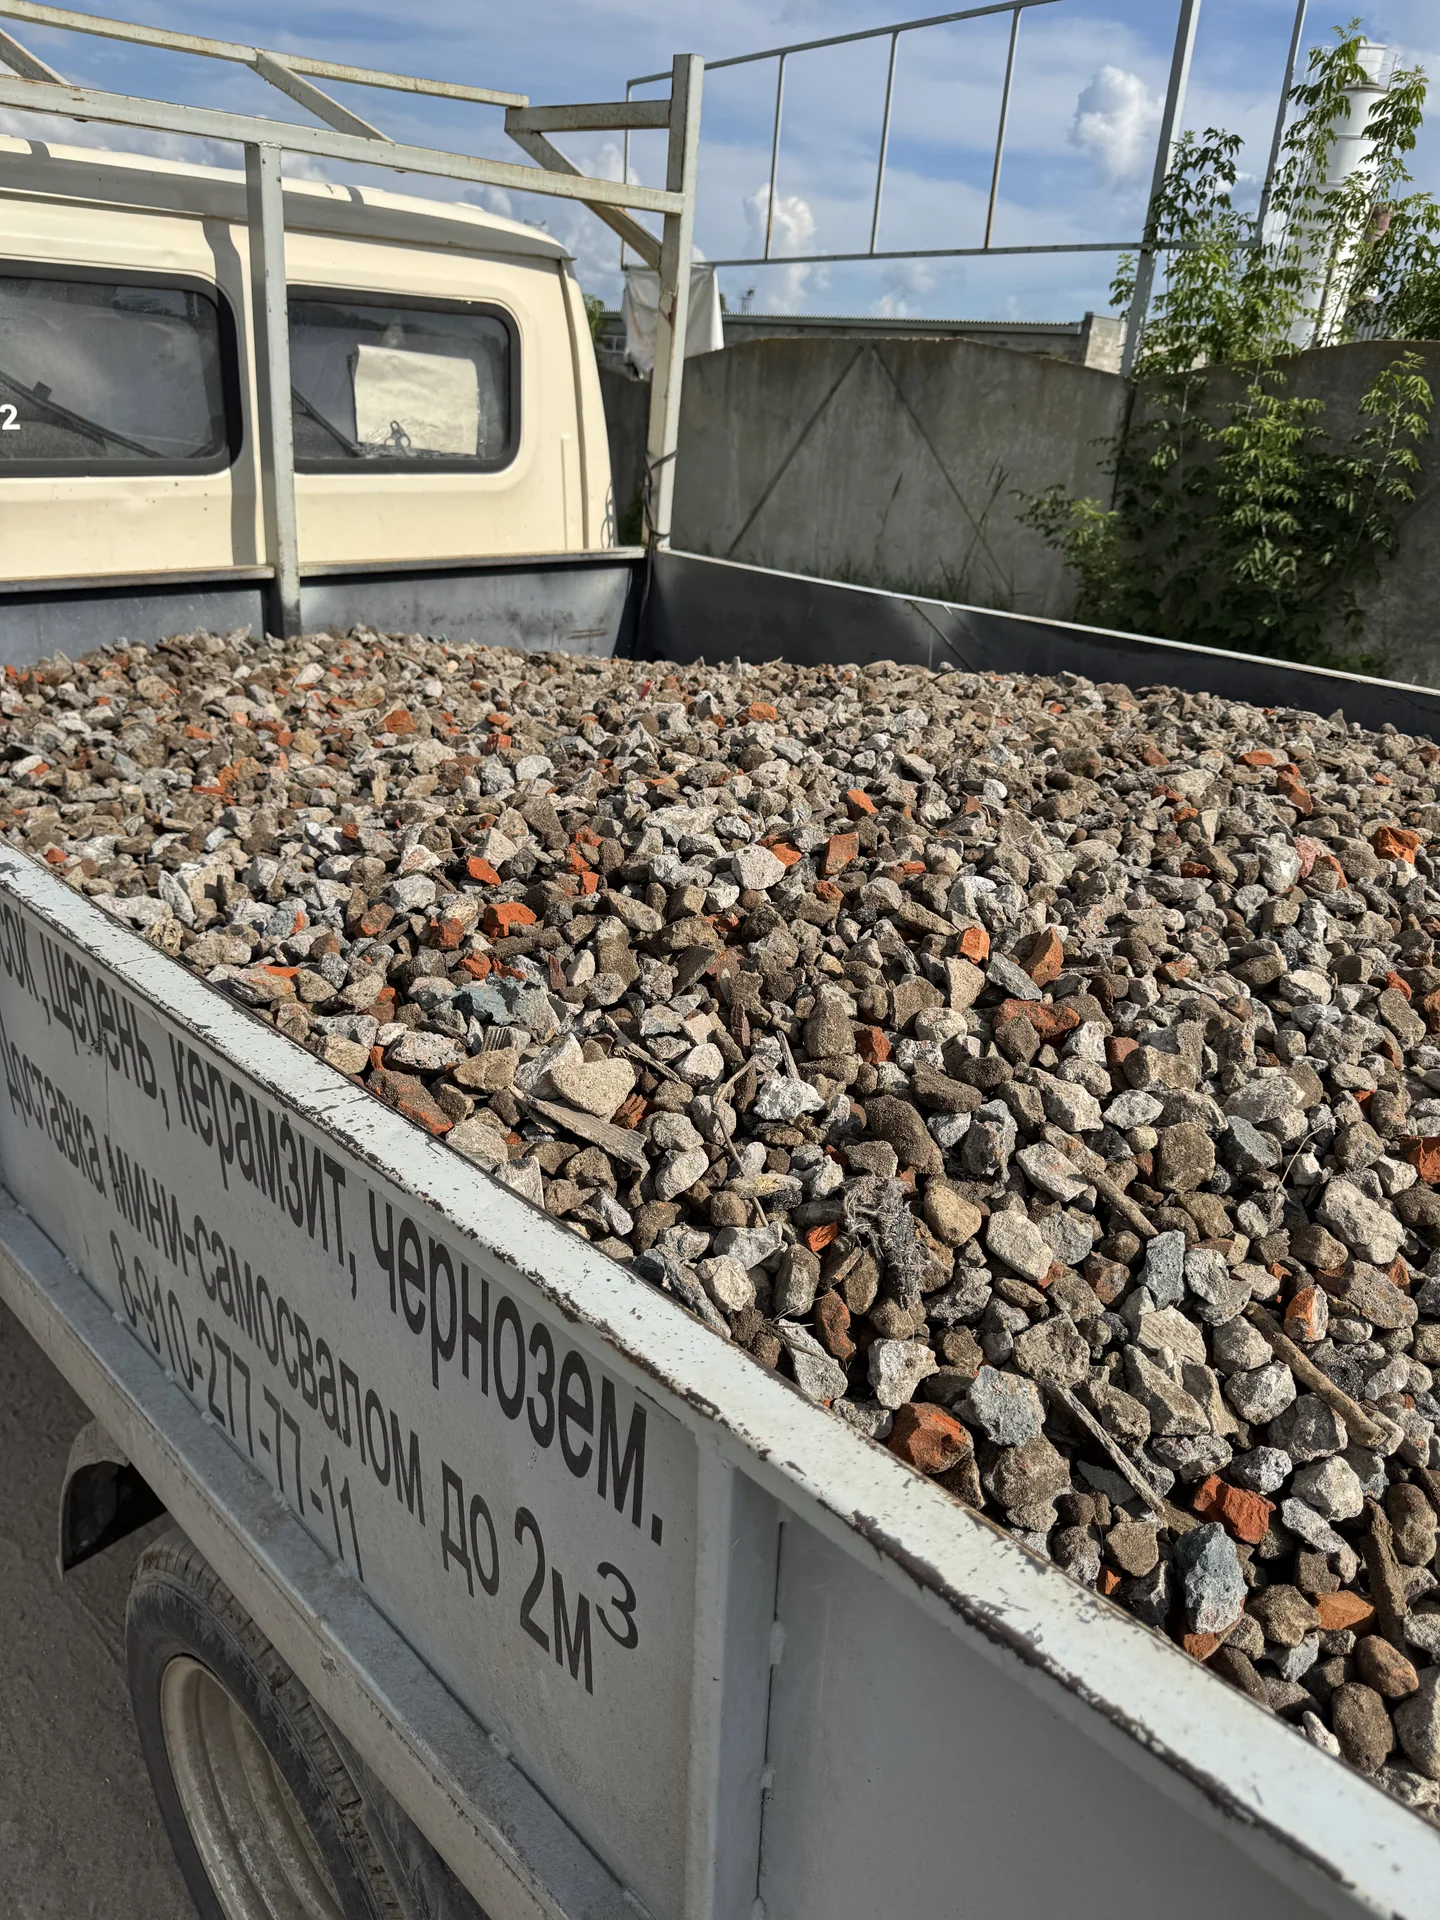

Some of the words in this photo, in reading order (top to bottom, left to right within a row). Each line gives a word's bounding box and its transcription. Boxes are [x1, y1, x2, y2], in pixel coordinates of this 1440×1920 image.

[104, 1134, 426, 1527] мини-самосвалом
[441, 1460, 499, 1597] до
[110, 1229, 364, 1583] 8-910-277-77-11
[168, 1032, 357, 1301] керамзит,
[369, 1188, 663, 1546] чернозем.
